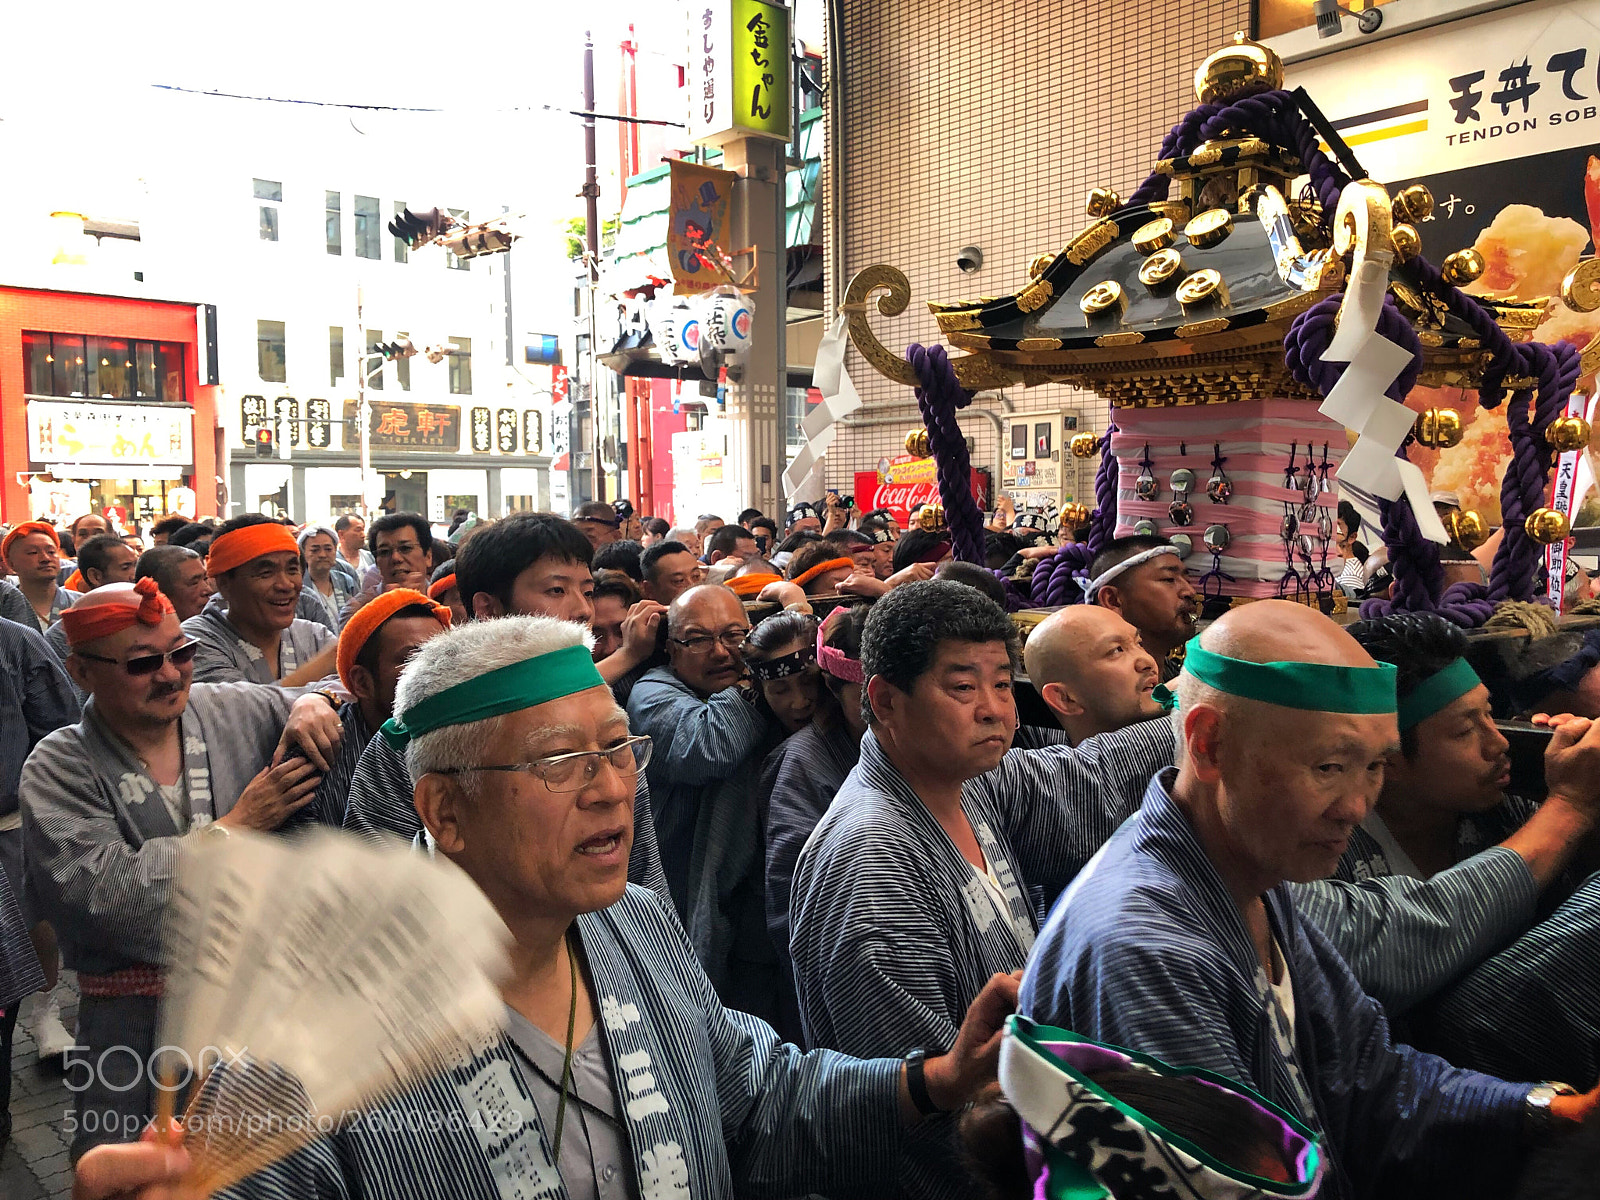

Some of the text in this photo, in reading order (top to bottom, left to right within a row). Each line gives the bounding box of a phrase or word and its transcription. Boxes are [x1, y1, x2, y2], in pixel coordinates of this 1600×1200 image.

[701, 8, 715, 124] すしや通り
[1448, 48, 1600, 124] 天丼て
[1446, 118, 1538, 146] TENDON
